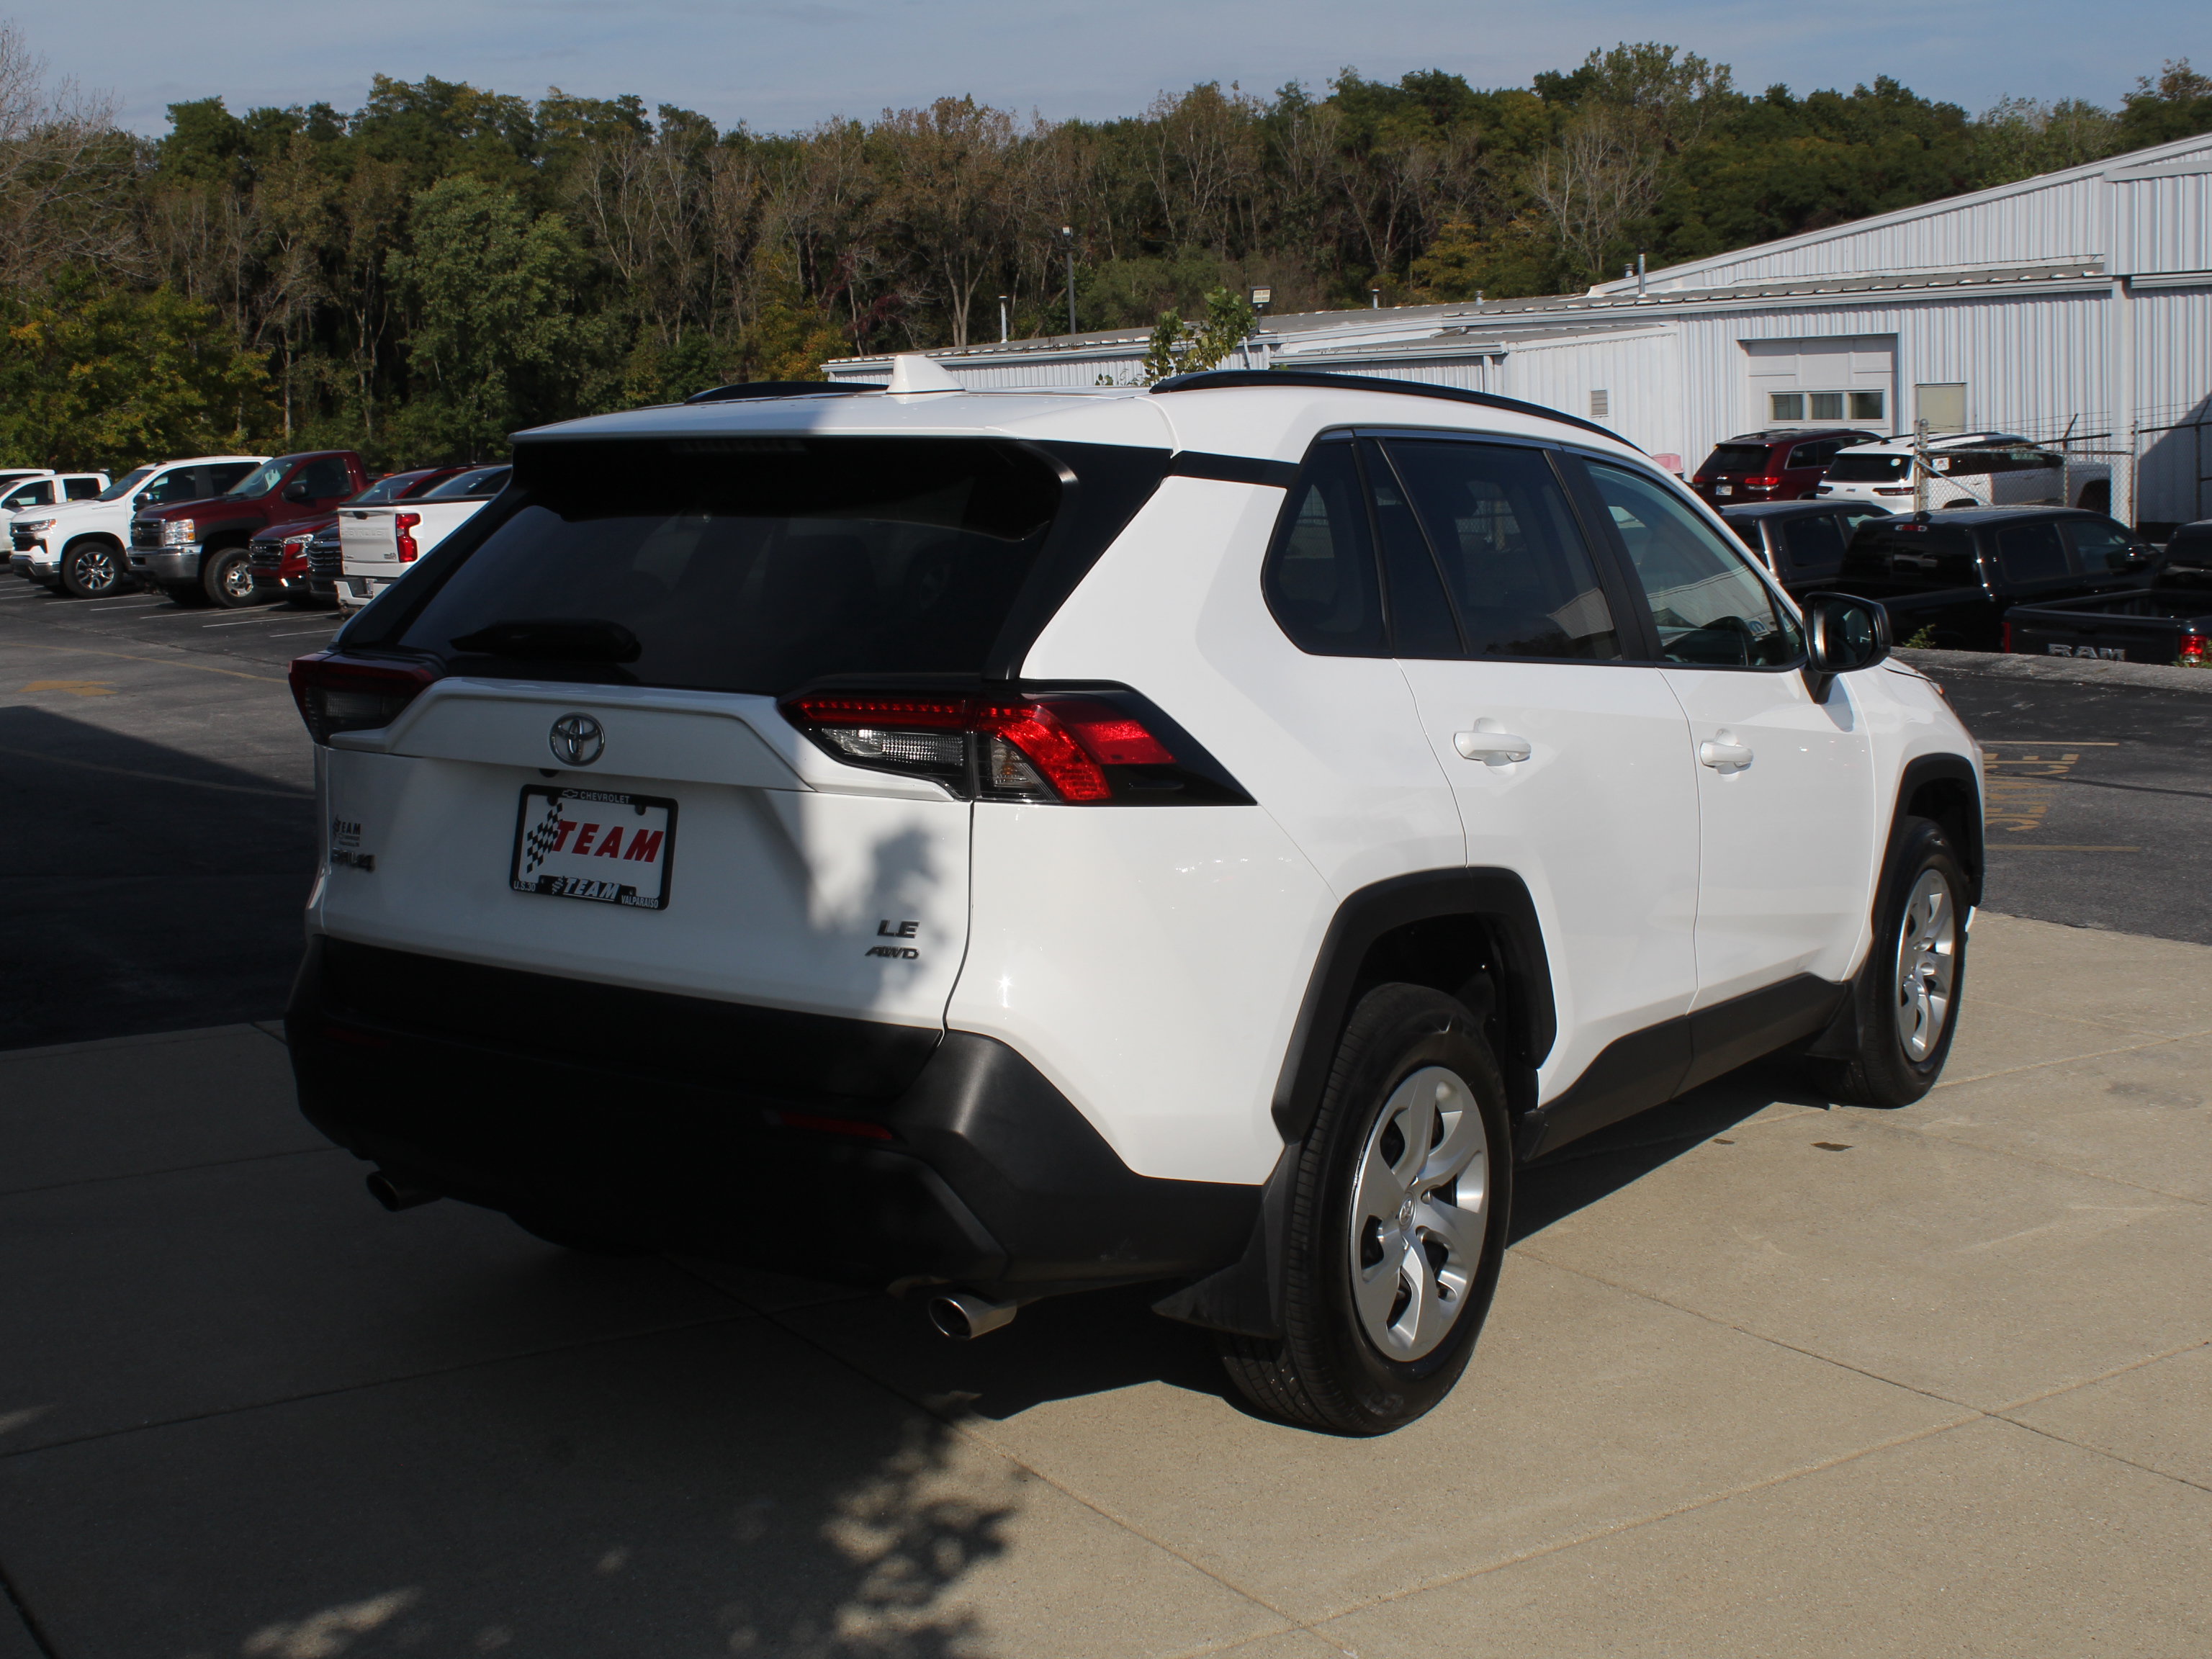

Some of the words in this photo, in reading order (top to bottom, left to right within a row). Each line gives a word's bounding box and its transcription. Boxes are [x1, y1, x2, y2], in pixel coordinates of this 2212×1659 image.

[2048, 643, 2126, 661] RAM
[580, 791, 630, 804] CHEVROLET
[552, 820, 664, 863] TEAM
[563, 877, 621, 899] TEAM
[621, 895, 659, 909] VALPARAISO
[877, 920, 920, 939] LE
[865, 945, 920, 960] AWD
